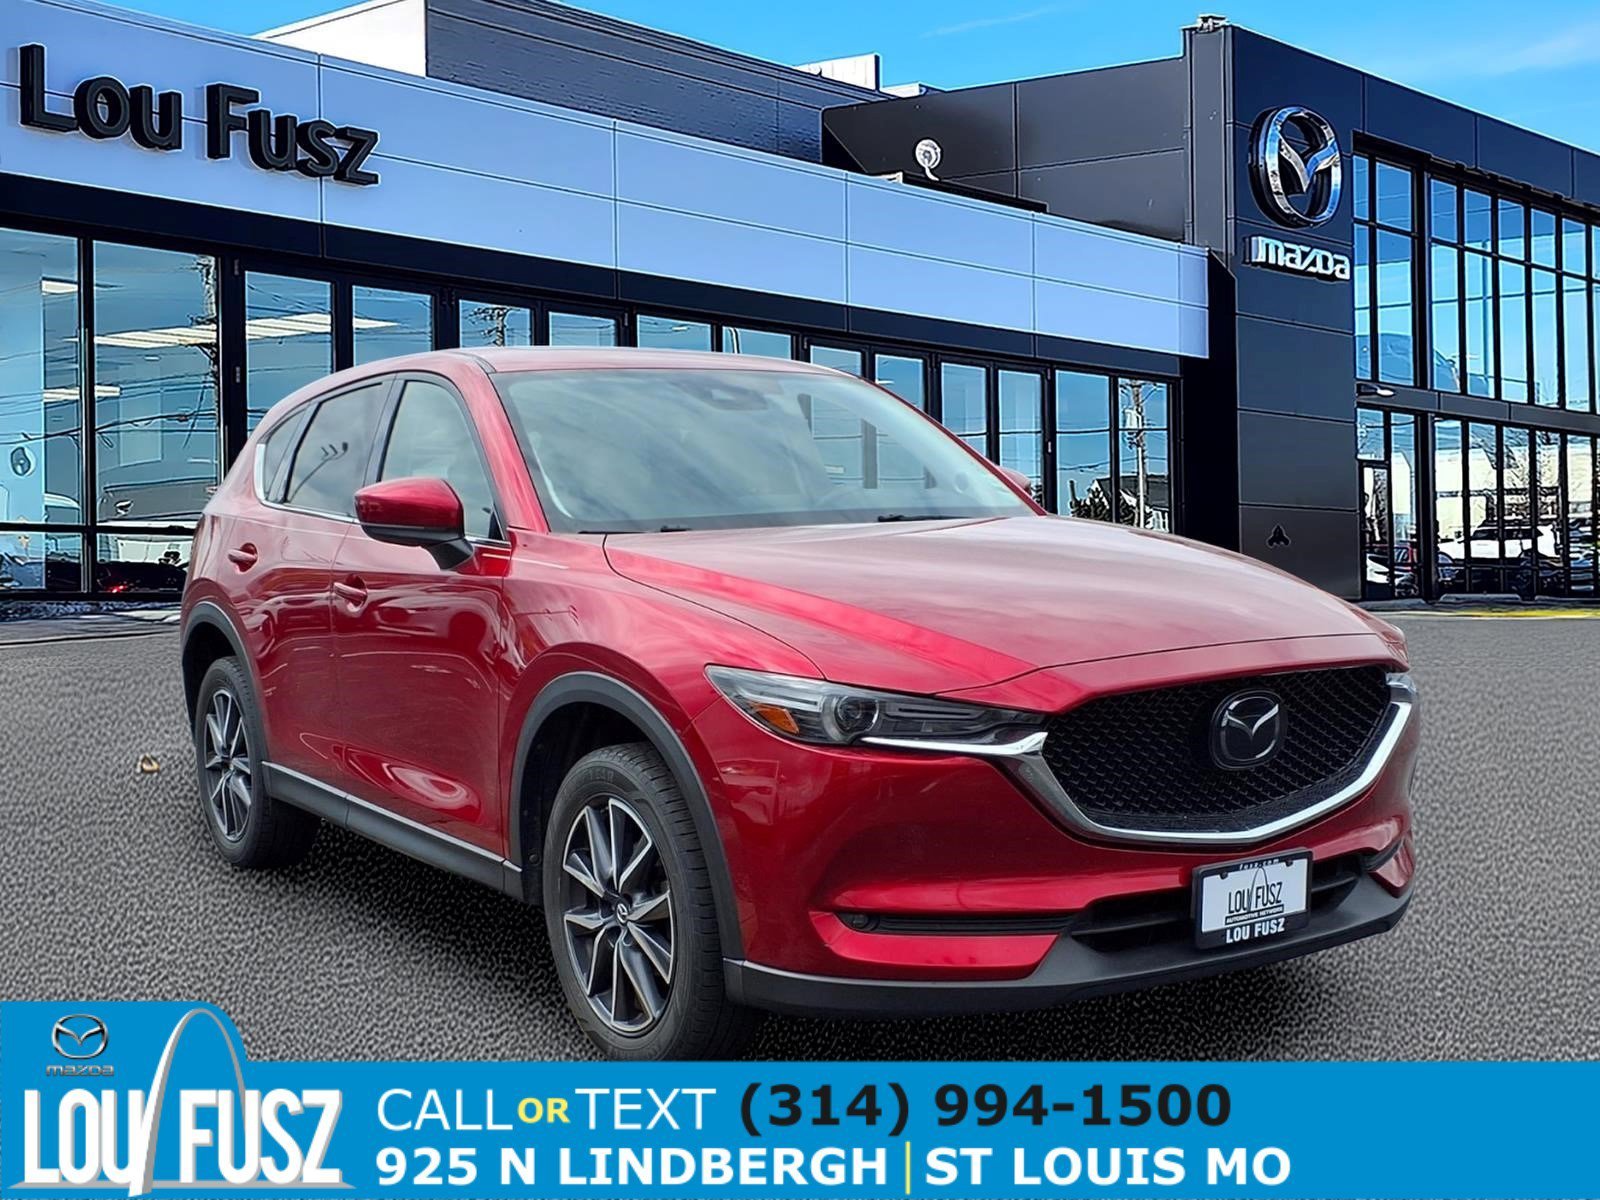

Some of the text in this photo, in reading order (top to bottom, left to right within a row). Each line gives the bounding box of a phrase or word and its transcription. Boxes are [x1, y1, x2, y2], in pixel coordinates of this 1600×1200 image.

[19, 44, 379, 185] Lou Fusz
[1251, 236, 1350, 280] mazda
[1228, 882, 1282, 913] LOU FUSZ
[1226, 918, 1285, 944] LOU FUSZ
